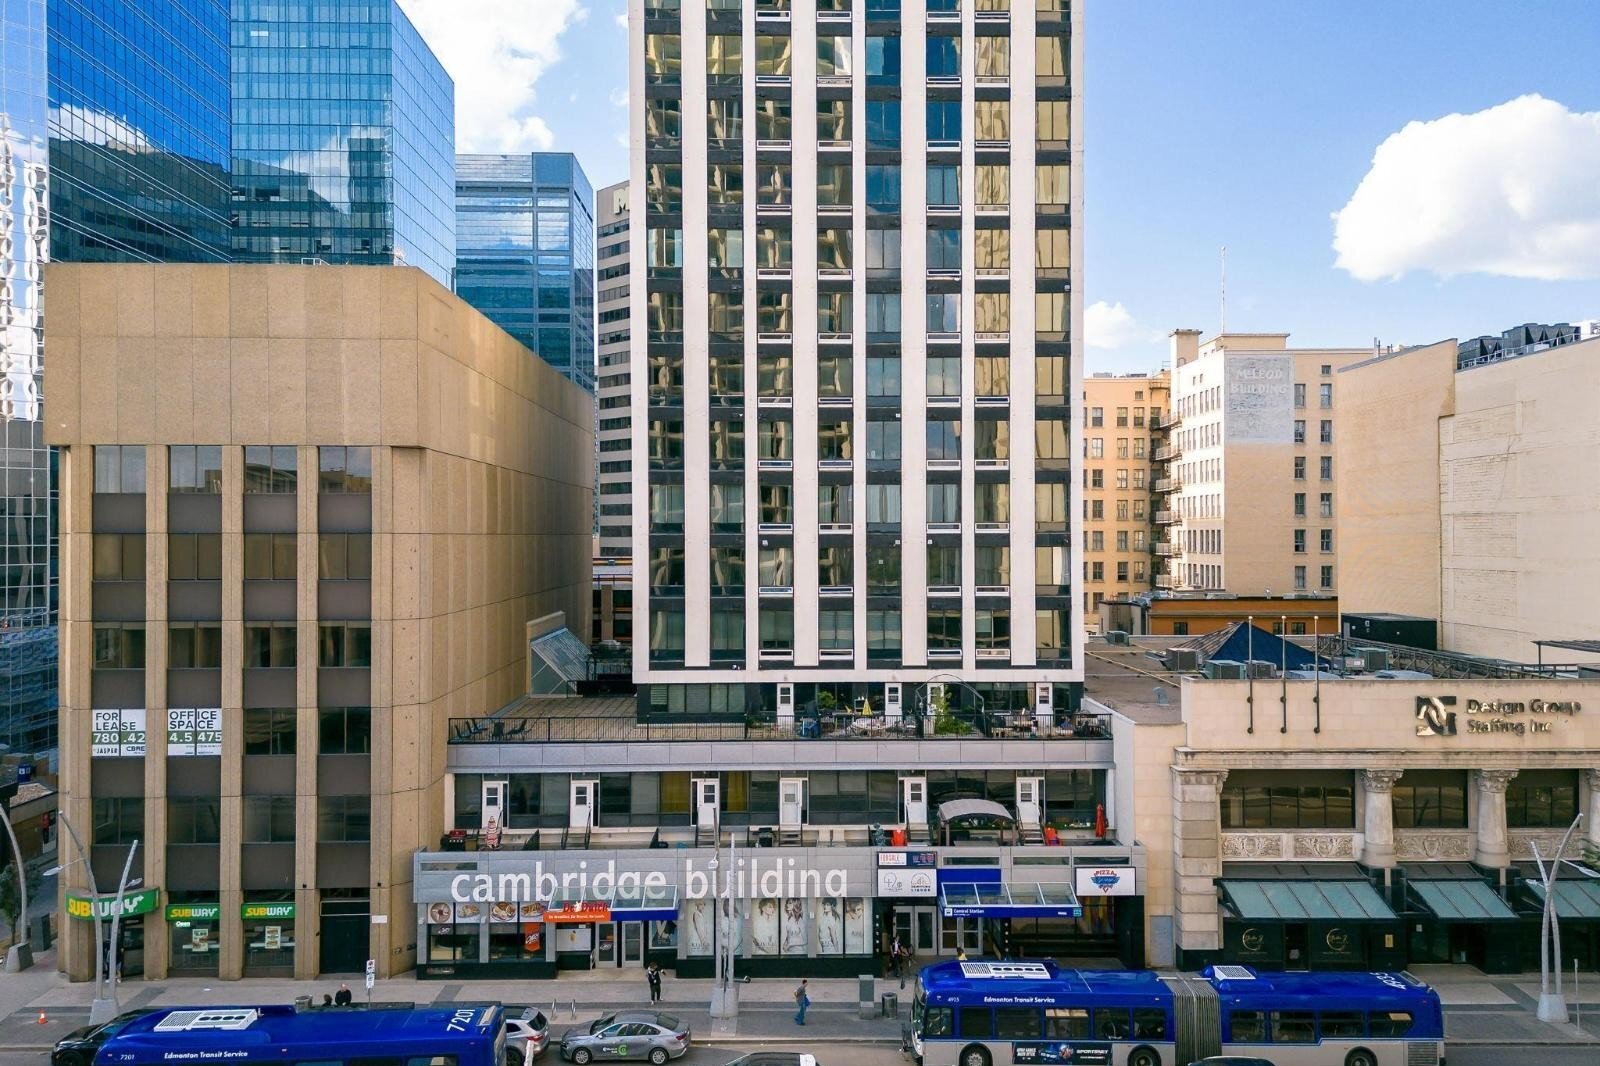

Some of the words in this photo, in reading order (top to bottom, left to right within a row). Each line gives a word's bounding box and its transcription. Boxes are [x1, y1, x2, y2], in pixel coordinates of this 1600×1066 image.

[1466, 698, 1525, 716] Design
[1529, 698, 1582, 716] Group
[95, 712, 119, 721] FOR
[169, 710, 217, 720] OFFICE
[95, 721, 136, 731] LEASE
[169, 720, 214, 730] SPACE
[1466, 718, 1526, 736] Staffing
[451, 859, 666, 902] cambridge
[685, 857, 848, 900] building
[170, 907, 218, 918] SUBWAY
[245, 906, 293, 917] SUBWAY
[446, 1009, 476, 1032] 7201
[164, 1052, 199, 1060] Edmonton
[200, 1051, 223, 1059] Transit
[223, 1050, 248, 1058] Service
